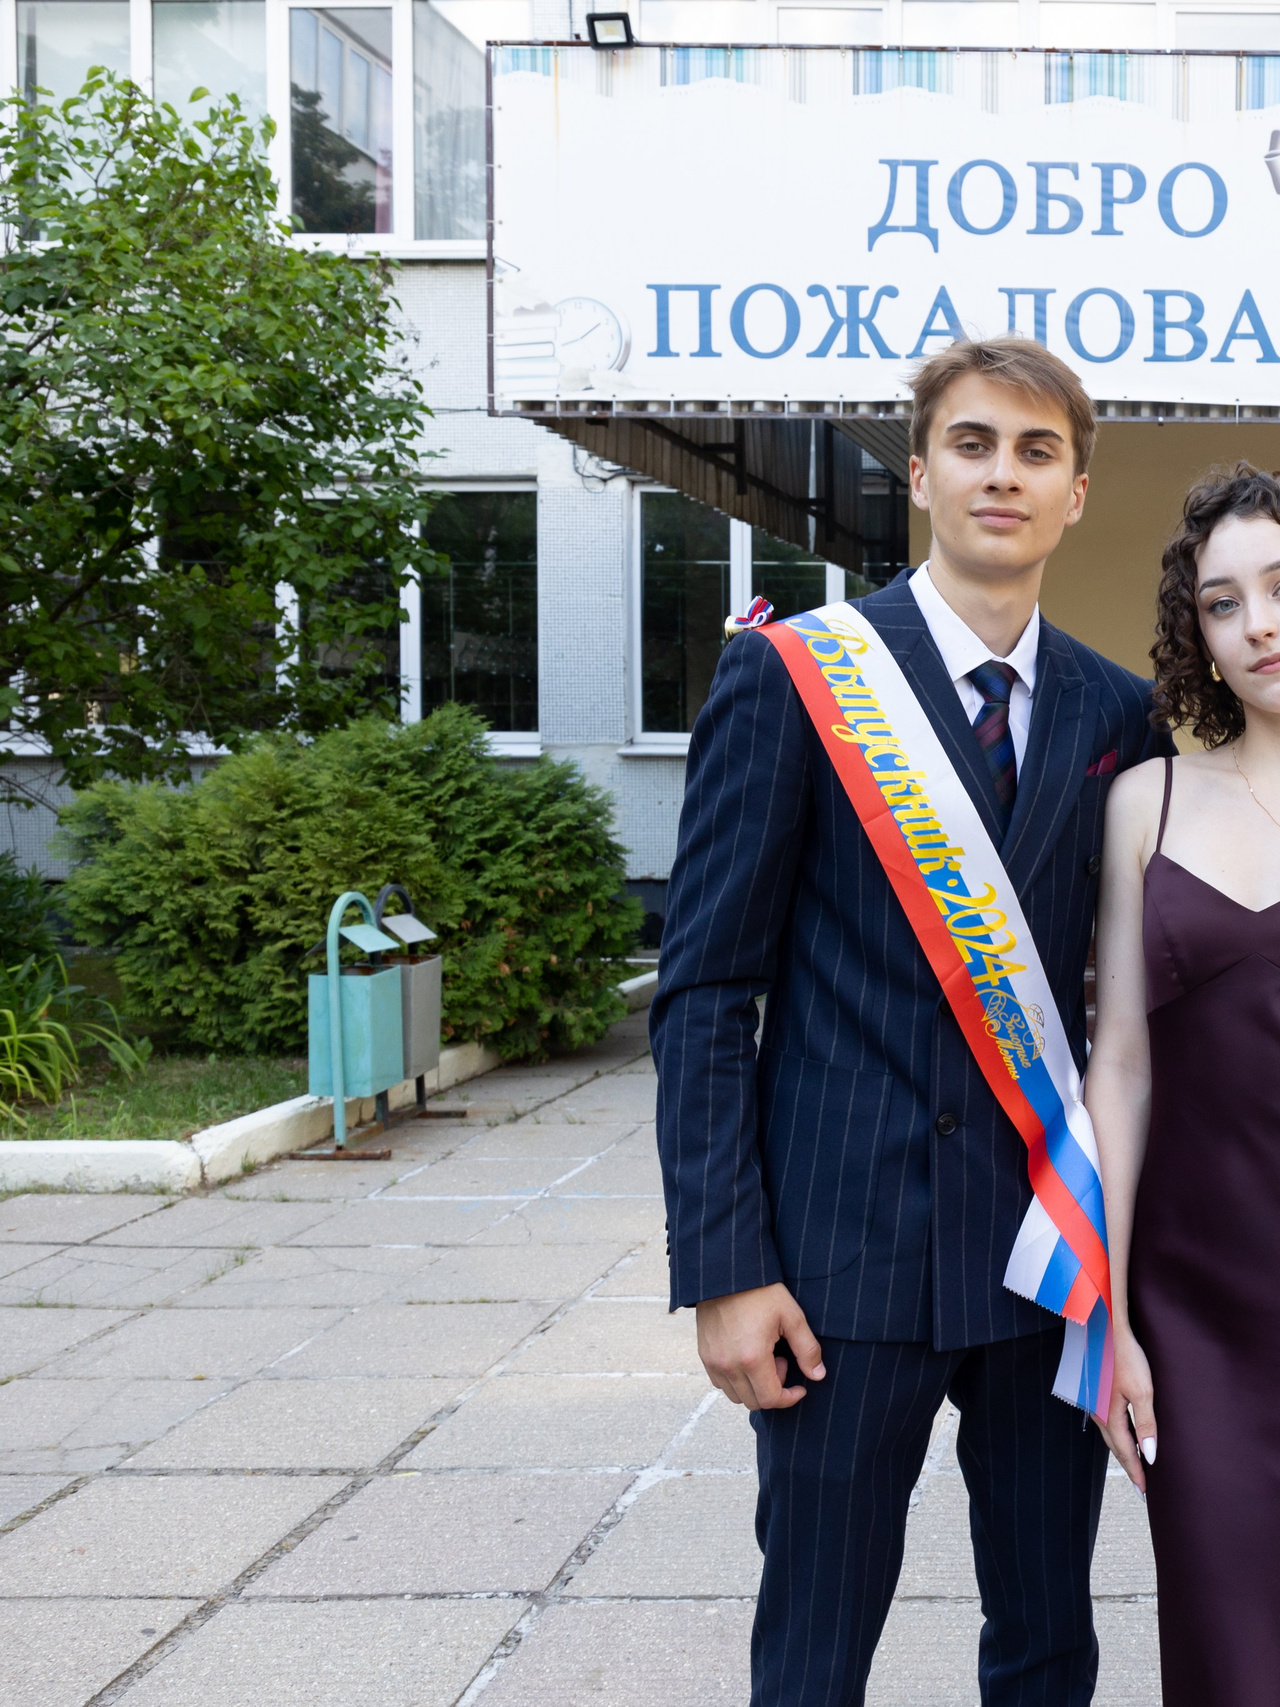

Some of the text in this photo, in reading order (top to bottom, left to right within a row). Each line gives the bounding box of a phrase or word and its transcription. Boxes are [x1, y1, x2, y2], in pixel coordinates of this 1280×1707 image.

[868, 160, 1227, 252] ДОБРО
[784, 618, 1027, 987] Выпускник 2024
